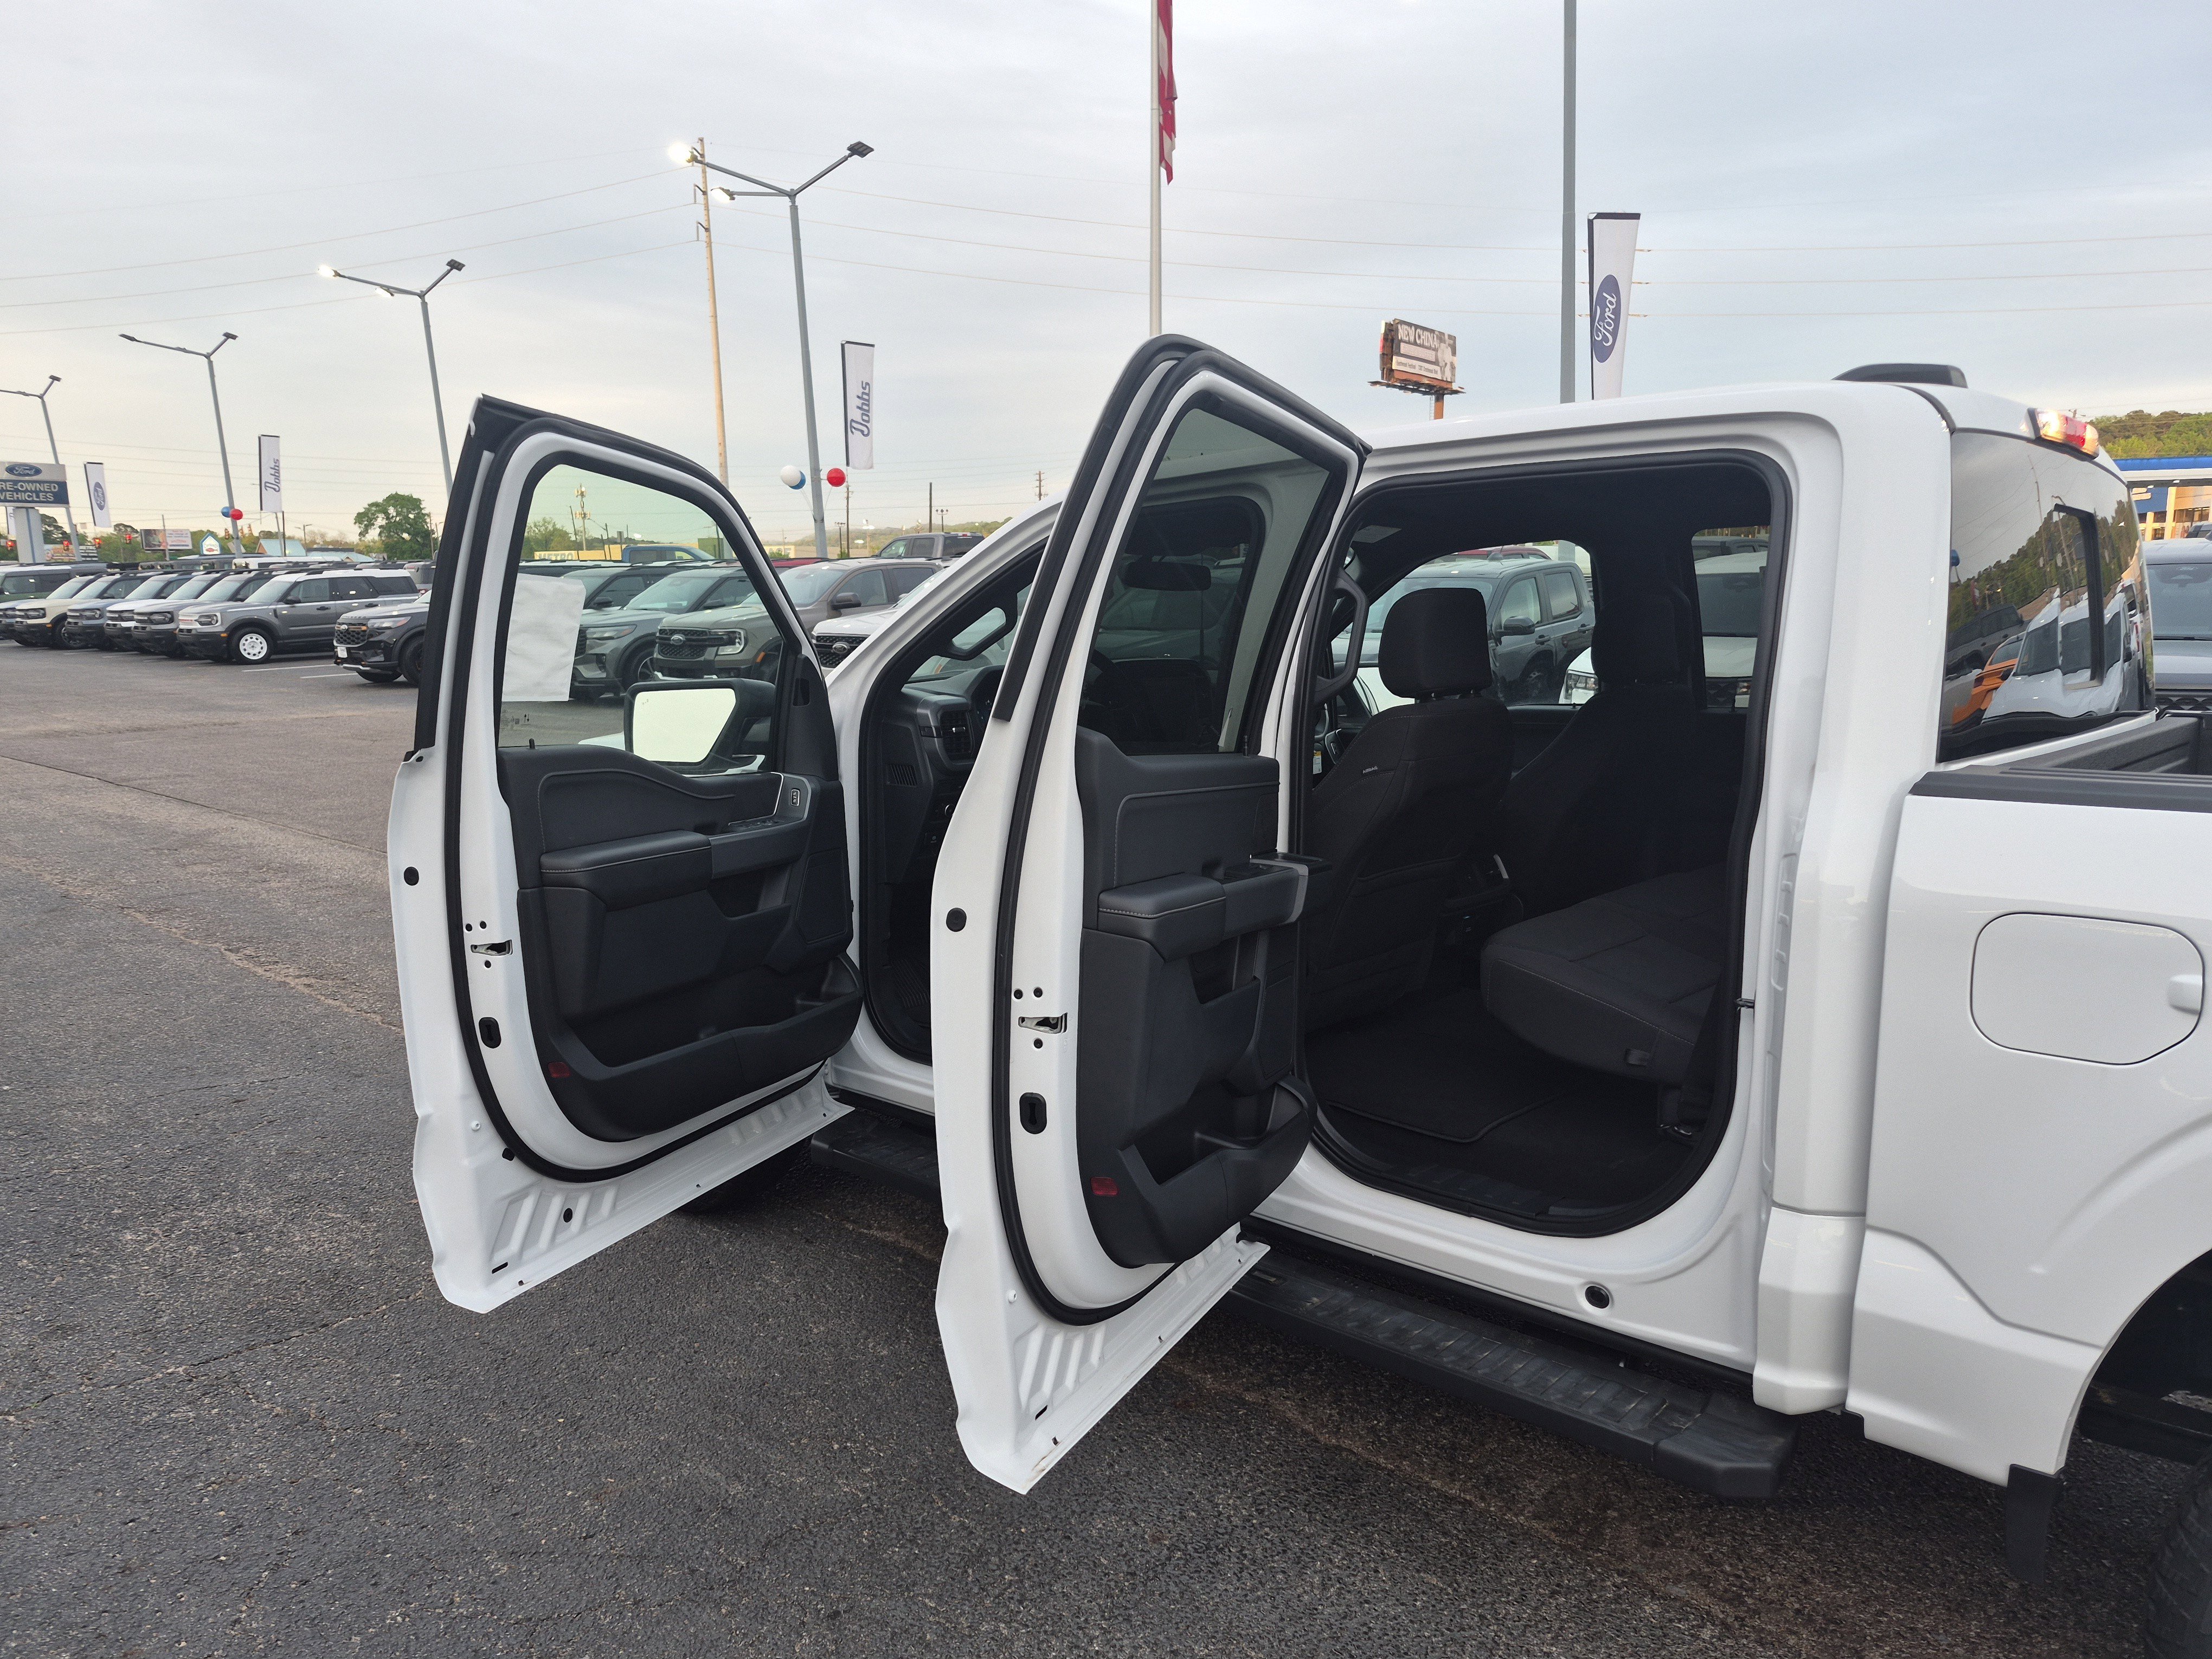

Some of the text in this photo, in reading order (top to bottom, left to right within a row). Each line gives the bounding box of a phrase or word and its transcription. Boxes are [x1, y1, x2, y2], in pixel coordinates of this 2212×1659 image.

[1594, 292, 1617, 346] Ford
[1398, 324, 1438, 349] NEW CHINA
[850, 381, 870, 438] Dobbs
[13, 466, 36, 474] Ford
[264, 458, 280, 492] Dobbs
[0, 491, 55, 501] VEHICLES
[94, 487, 105, 506] Ford
